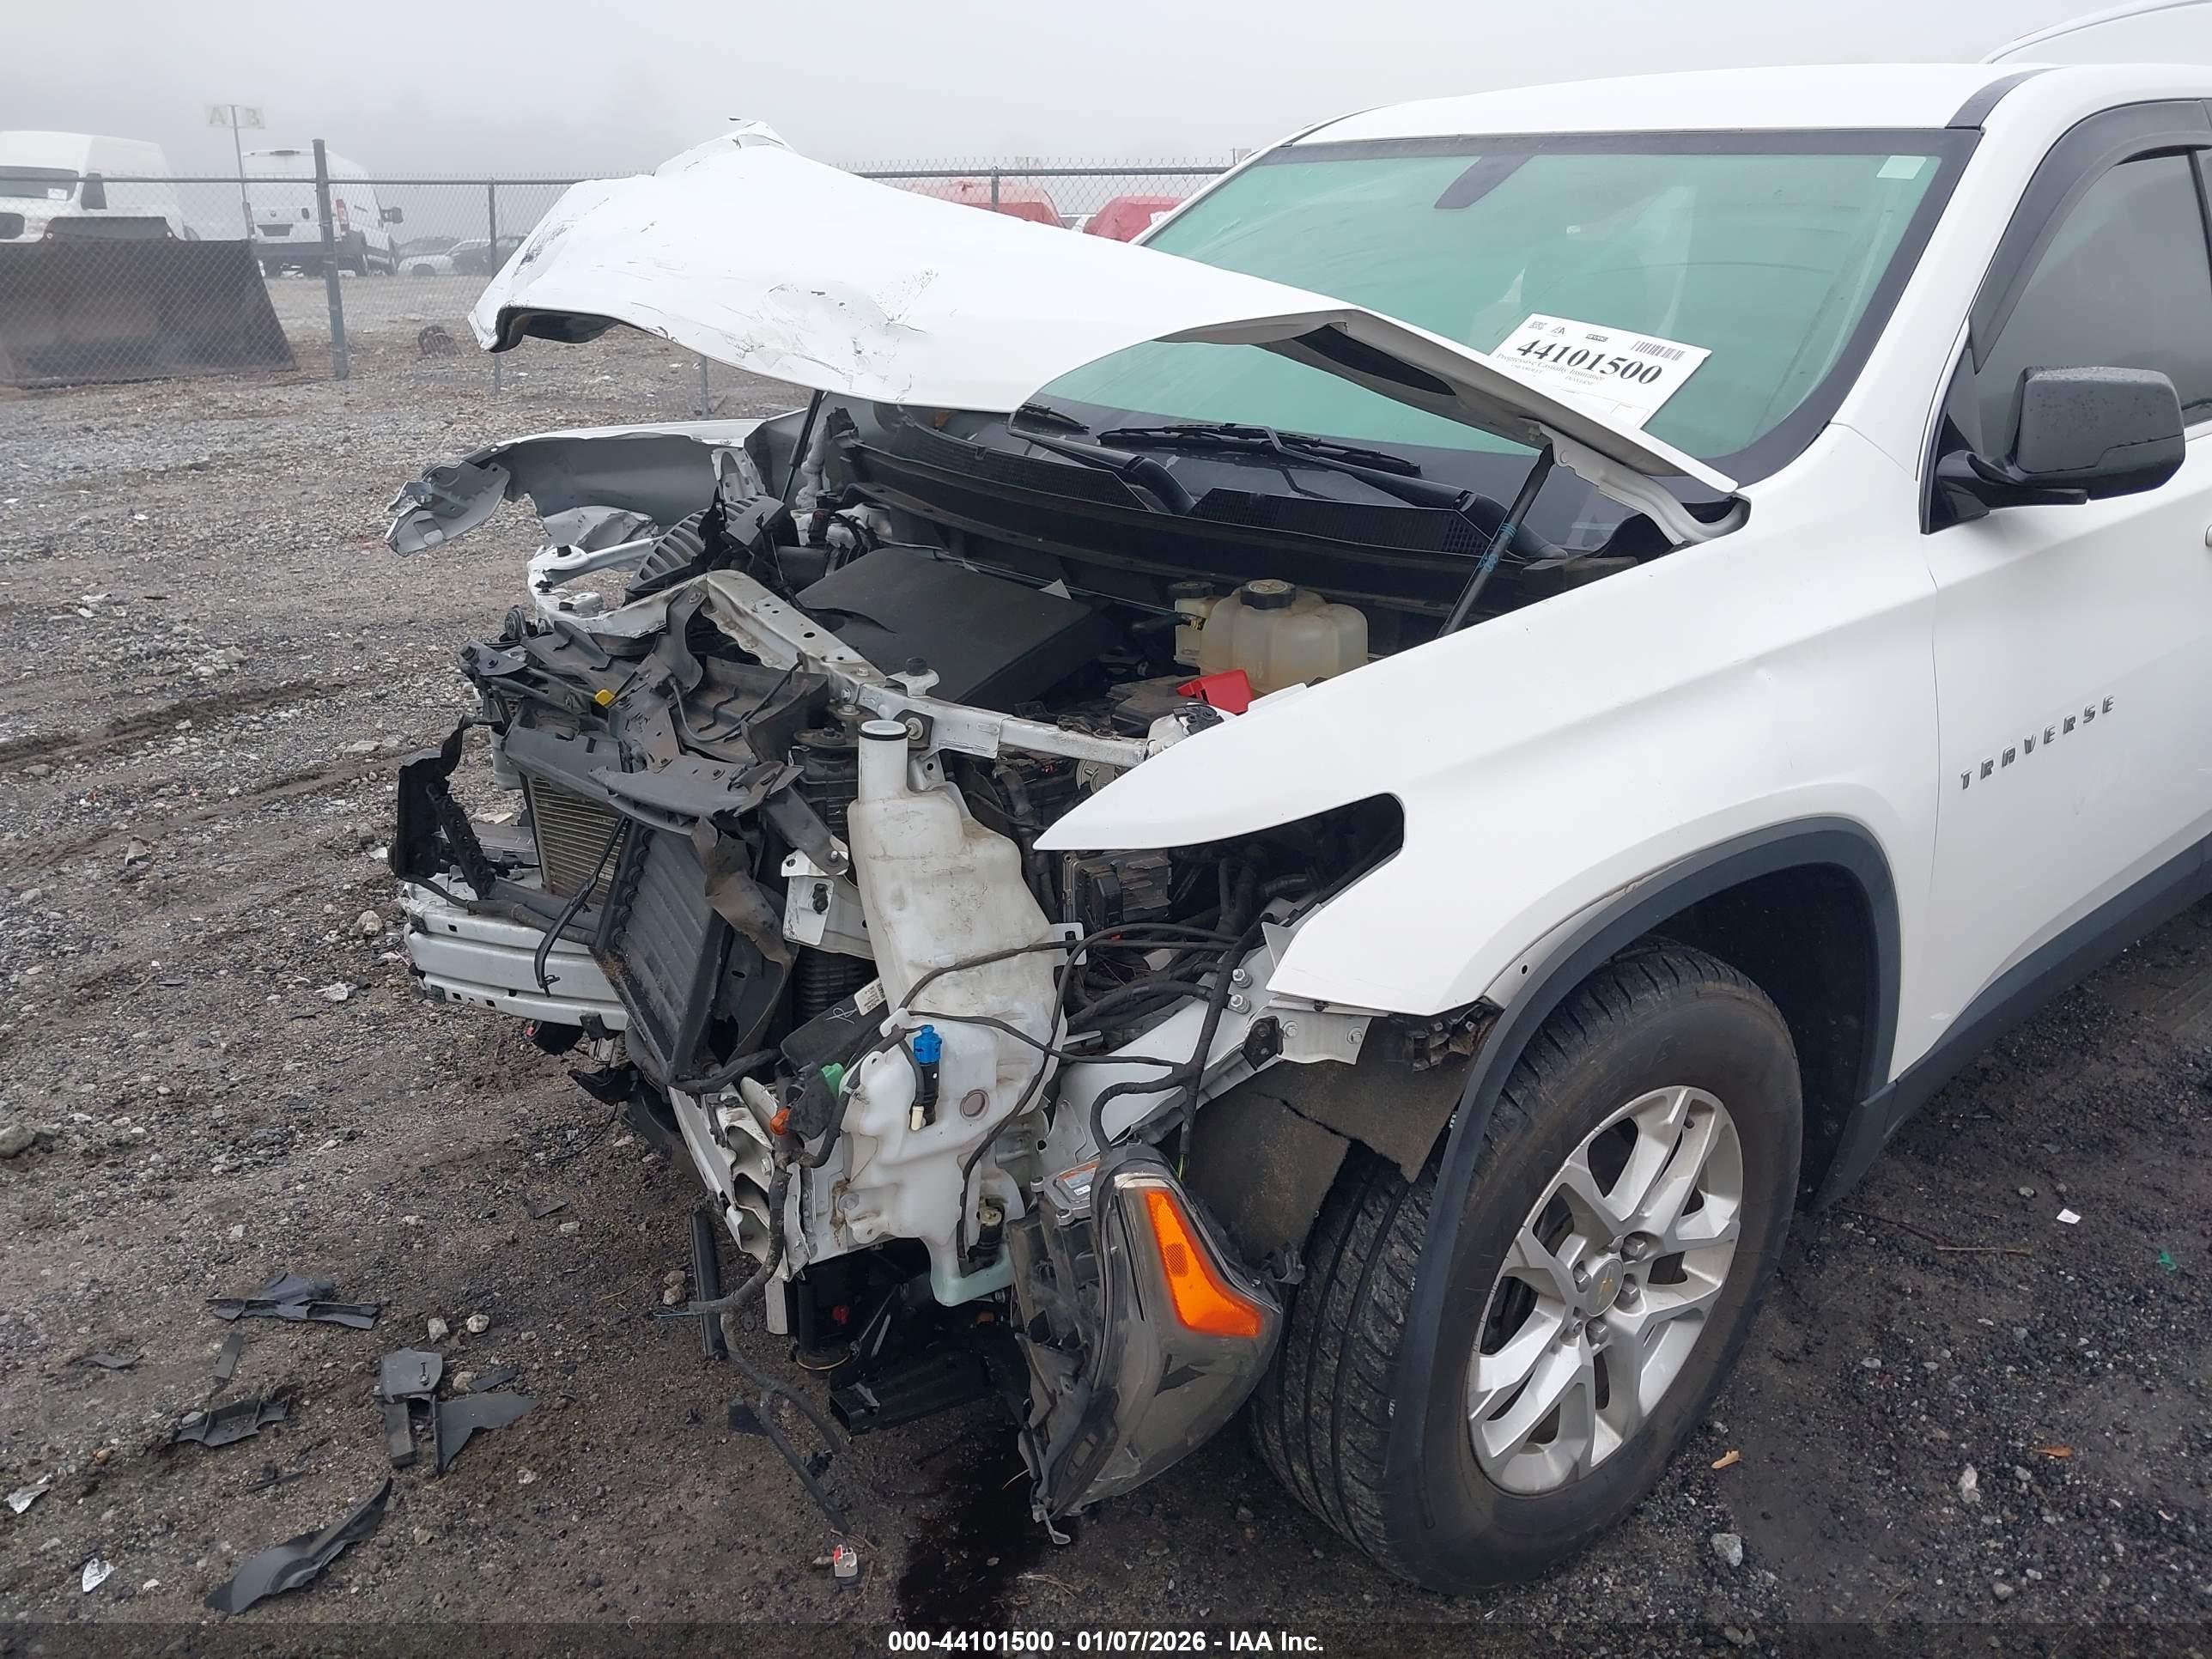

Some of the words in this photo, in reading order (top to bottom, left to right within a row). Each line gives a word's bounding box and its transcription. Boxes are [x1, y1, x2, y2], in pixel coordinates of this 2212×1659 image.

[1497, 353, 1537, 366] Progressive
[1570, 368, 1606, 381] Insurance
[1516, 339, 1662, 385] 44101500
[1960, 694, 2114, 791] TRAVERSE
